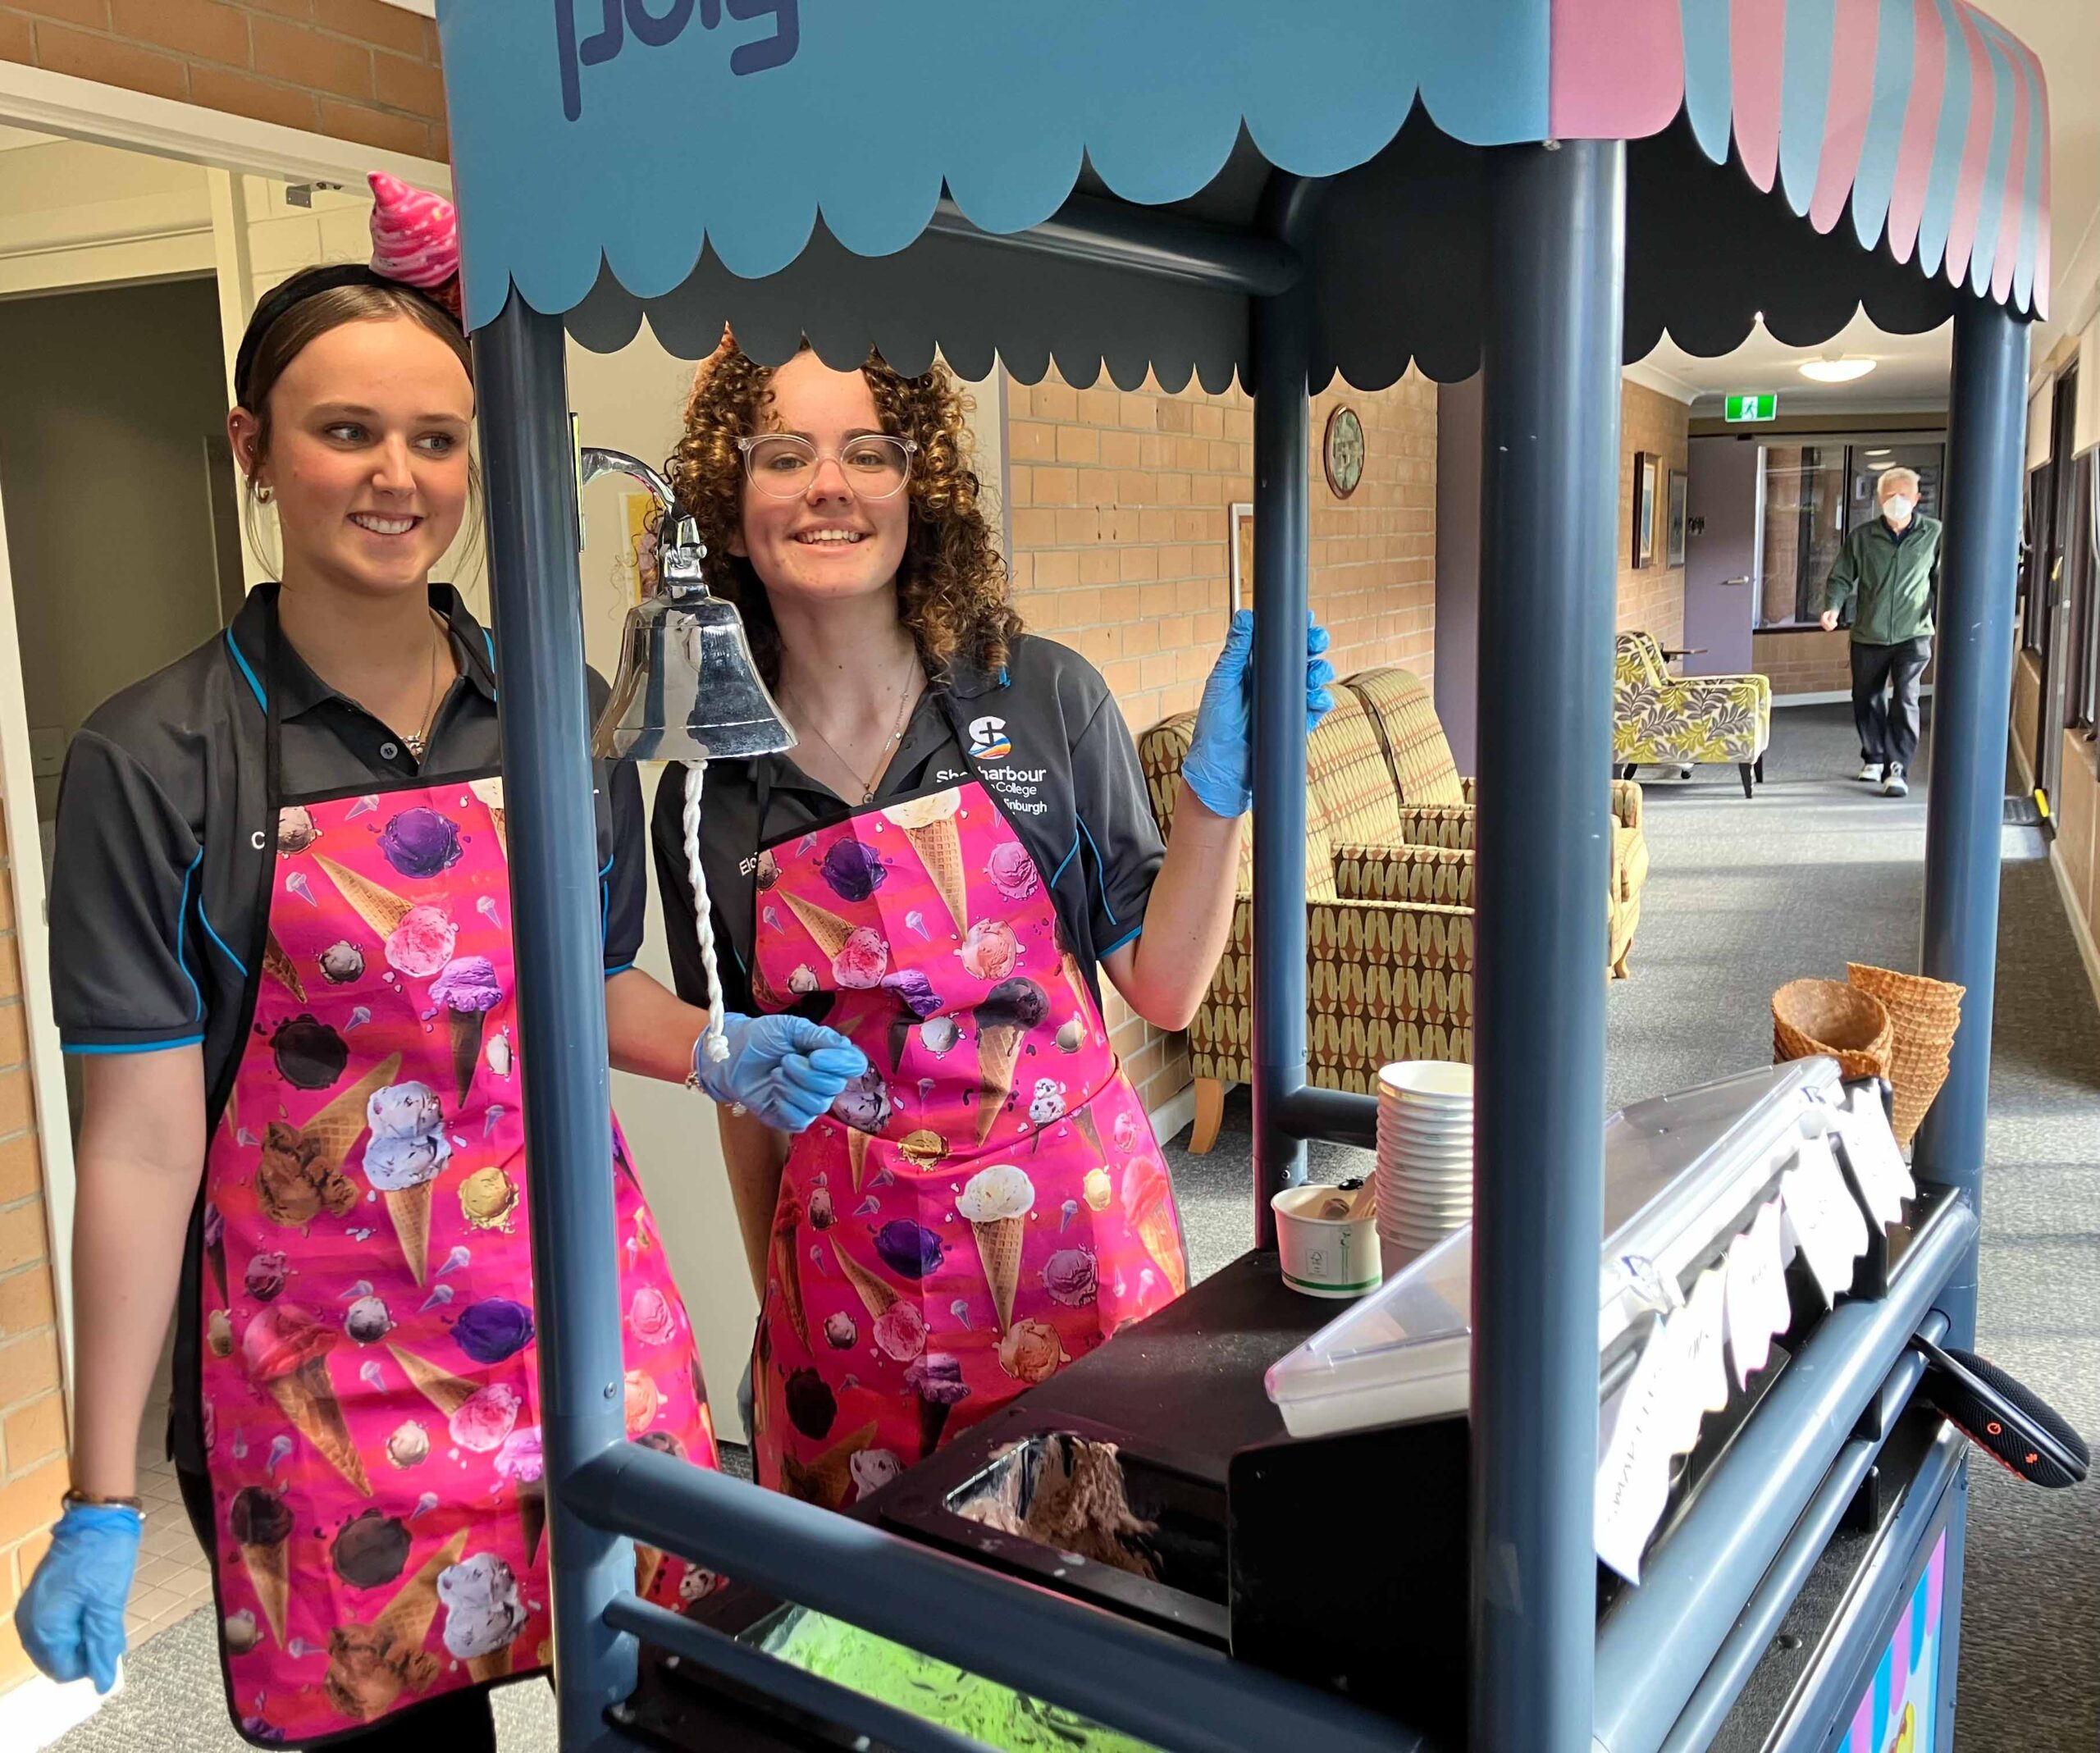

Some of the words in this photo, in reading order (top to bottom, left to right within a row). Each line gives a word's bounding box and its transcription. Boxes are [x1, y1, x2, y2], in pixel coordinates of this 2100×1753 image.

[936, 765, 1047, 783] Shharbour
[996, 781, 1037, 798] College
[1003, 797, 1048, 815] inburgh
[738, 851, 758, 876] Elo
